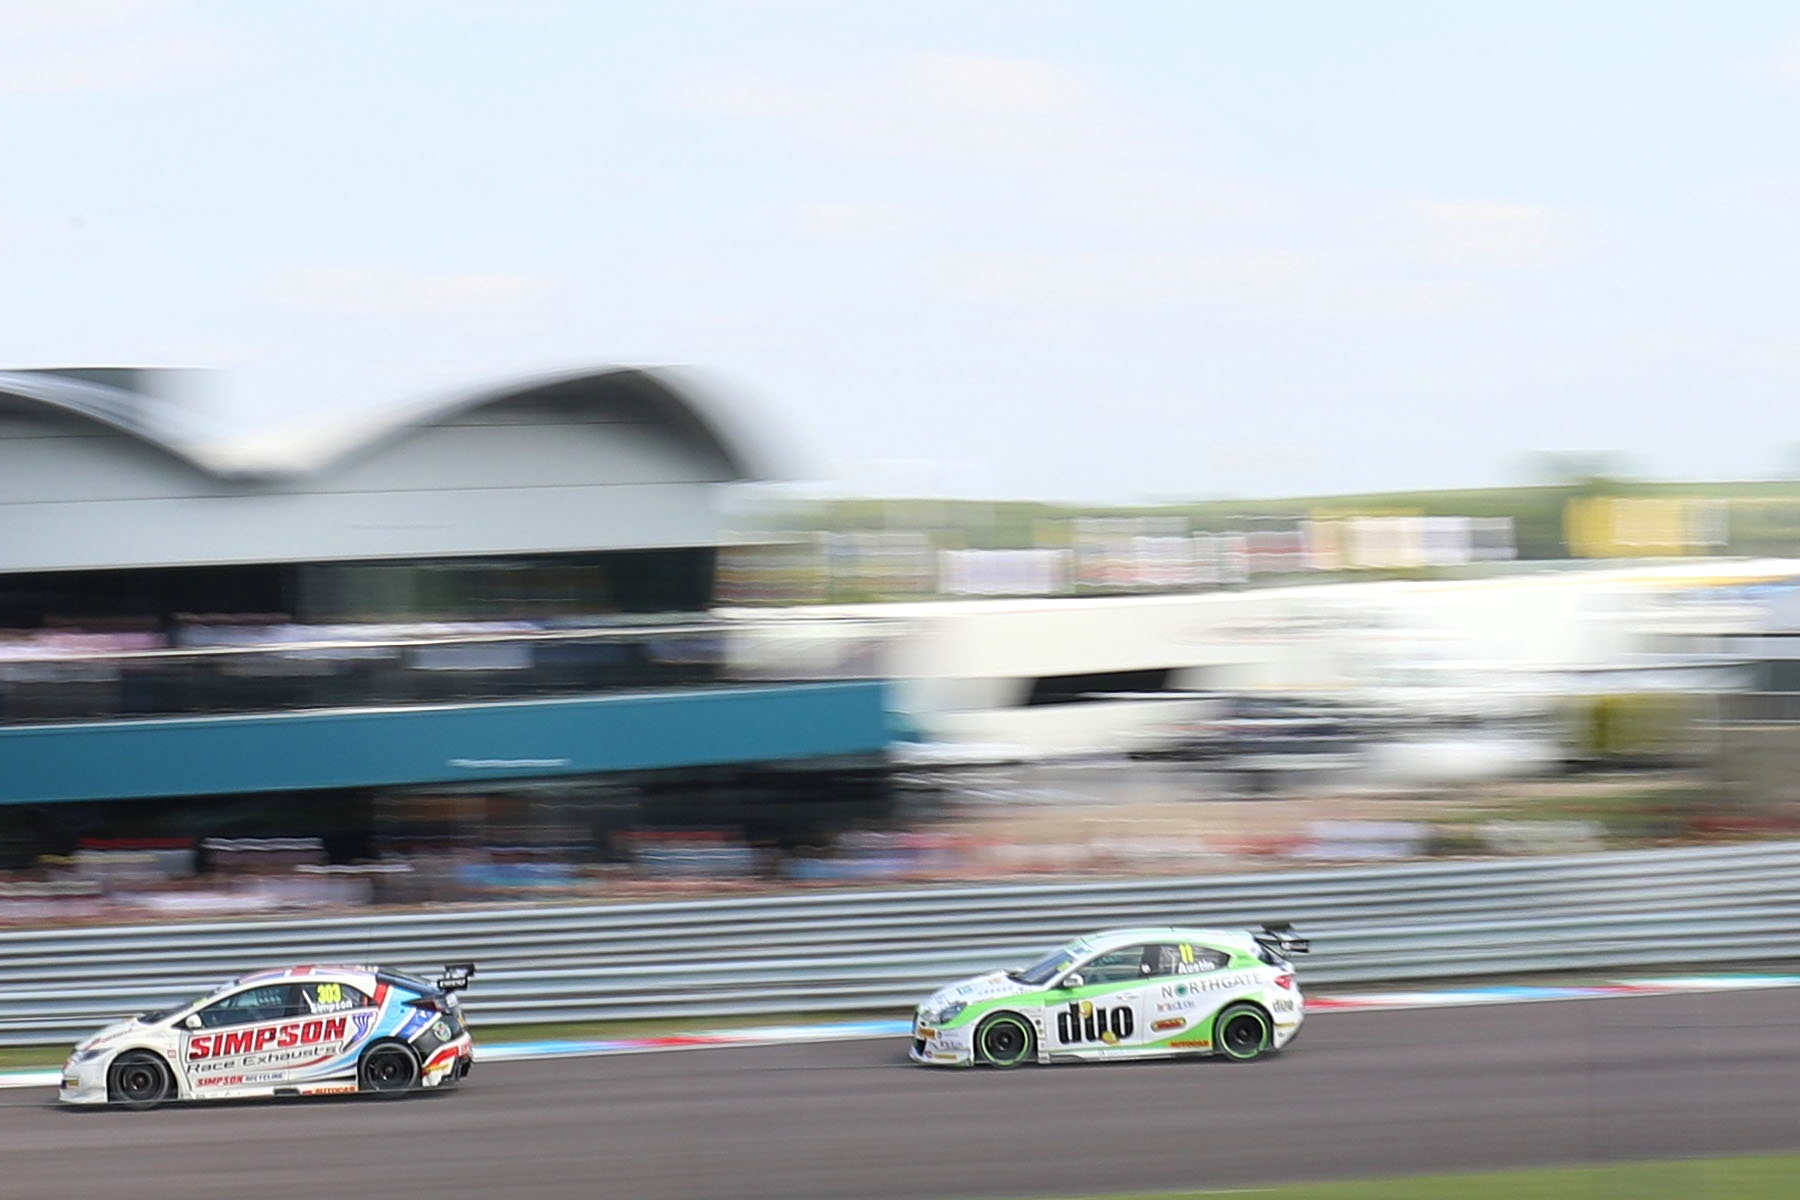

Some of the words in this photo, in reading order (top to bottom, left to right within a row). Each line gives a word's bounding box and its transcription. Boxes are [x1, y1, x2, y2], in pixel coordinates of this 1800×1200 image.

[1179, 944, 1193, 963] 11
[317, 983, 341, 1004] 303
[1161, 974, 1263, 998] NORTHGATE
[310, 1000, 353, 1015] Simpson
[1057, 1001, 1133, 1045] duo
[188, 1017, 347, 1061] SIMPSON
[186, 1062, 235, 1075] Race
[242, 1047, 336, 1067] Exhausts
[197, 1075, 244, 1087] SIMPSON
